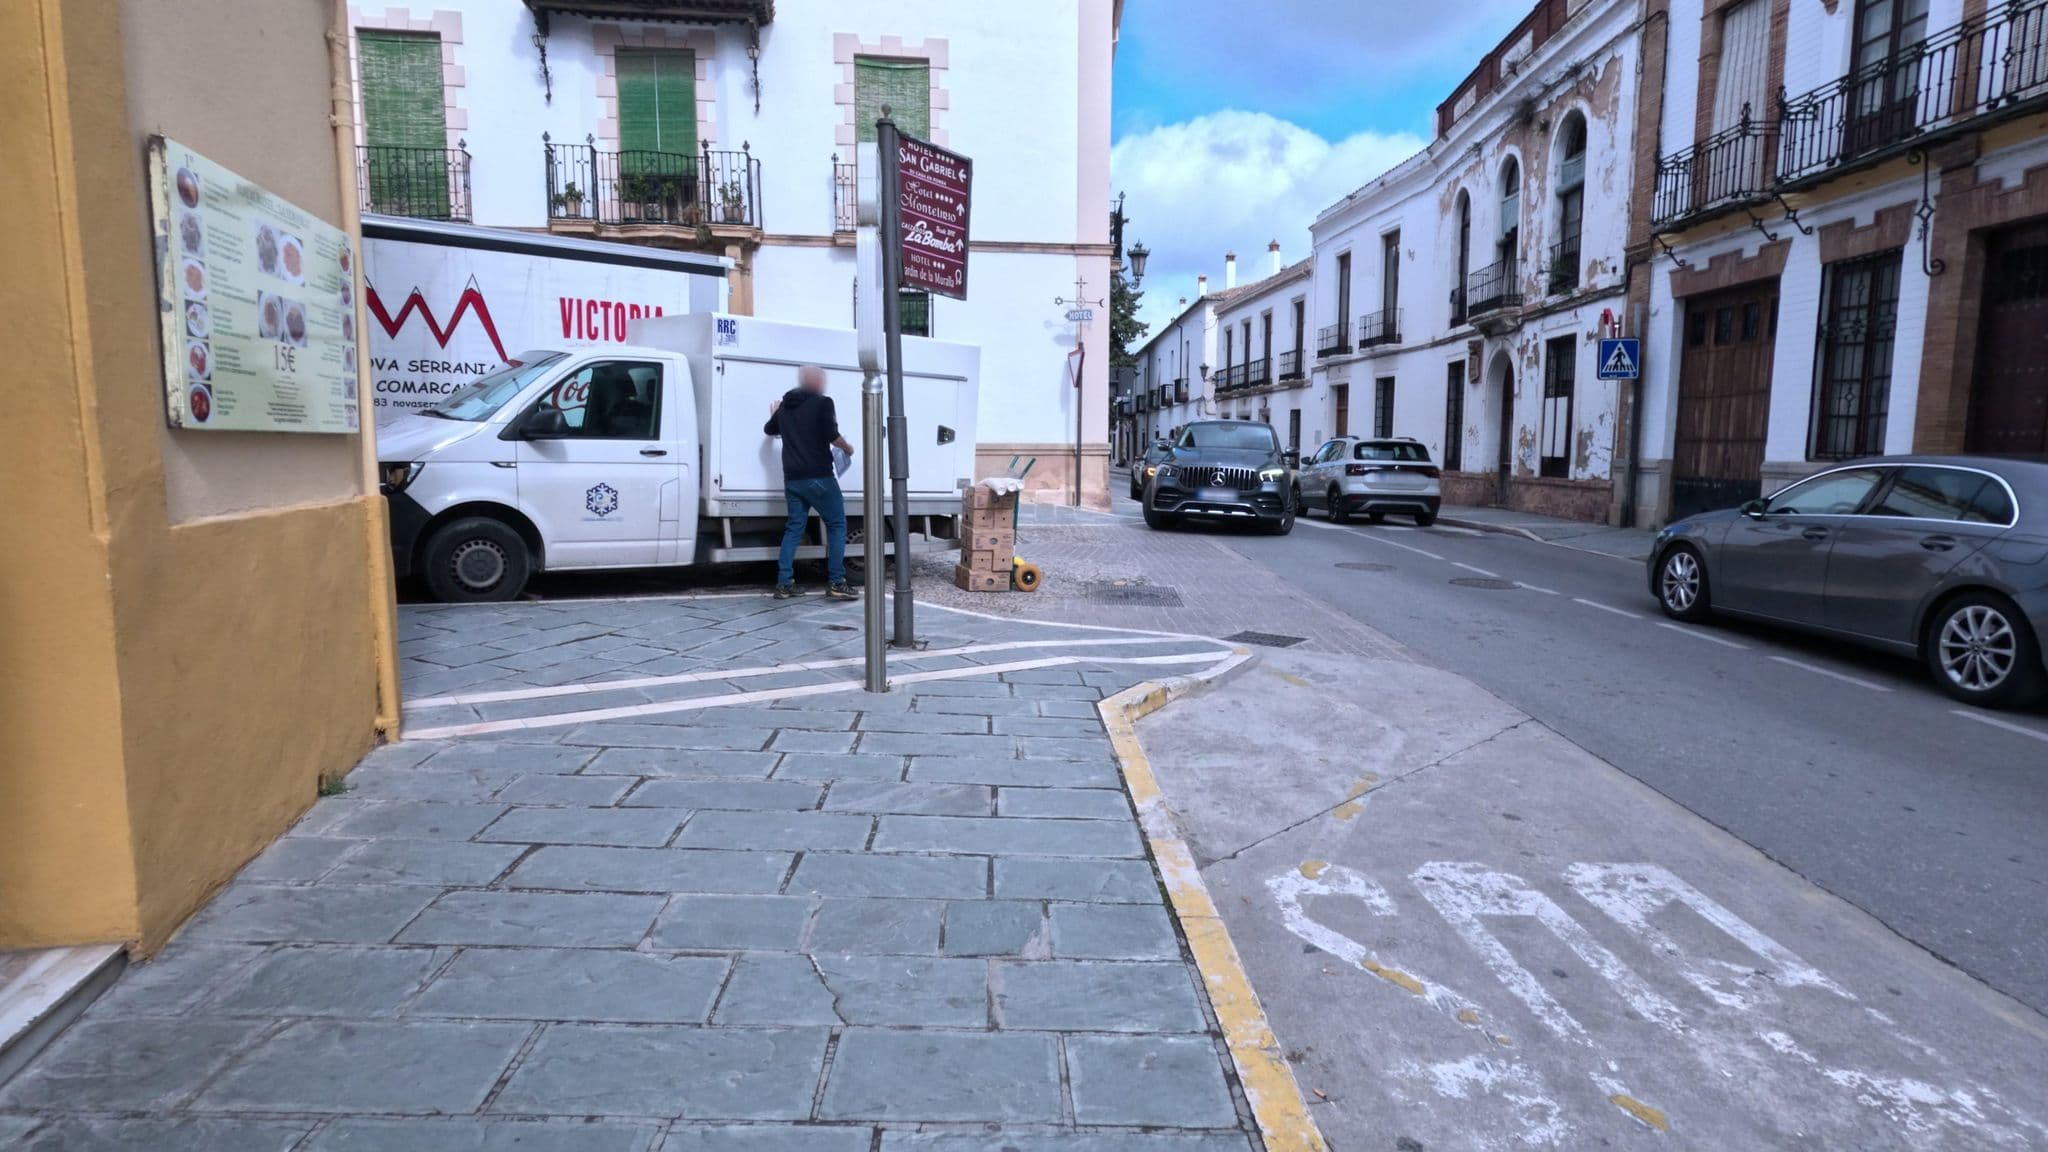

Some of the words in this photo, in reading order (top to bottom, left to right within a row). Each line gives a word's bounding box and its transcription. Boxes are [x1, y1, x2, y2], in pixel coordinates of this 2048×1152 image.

[907, 142, 934, 157] HOTEL
[900, 147, 917, 165] SAN
[920, 156, 957, 180] GABRIEL
[905, 181, 933, 199] Hotel
[921, 230, 956, 253] Bomba
[911, 253, 930, 266] HOTEL
[1069, 311, 1093, 321] HOTEL
[717, 319, 736, 334] RRC
[274, 344, 296, 373] 15€
[407, 360, 496, 375] SERRANI
